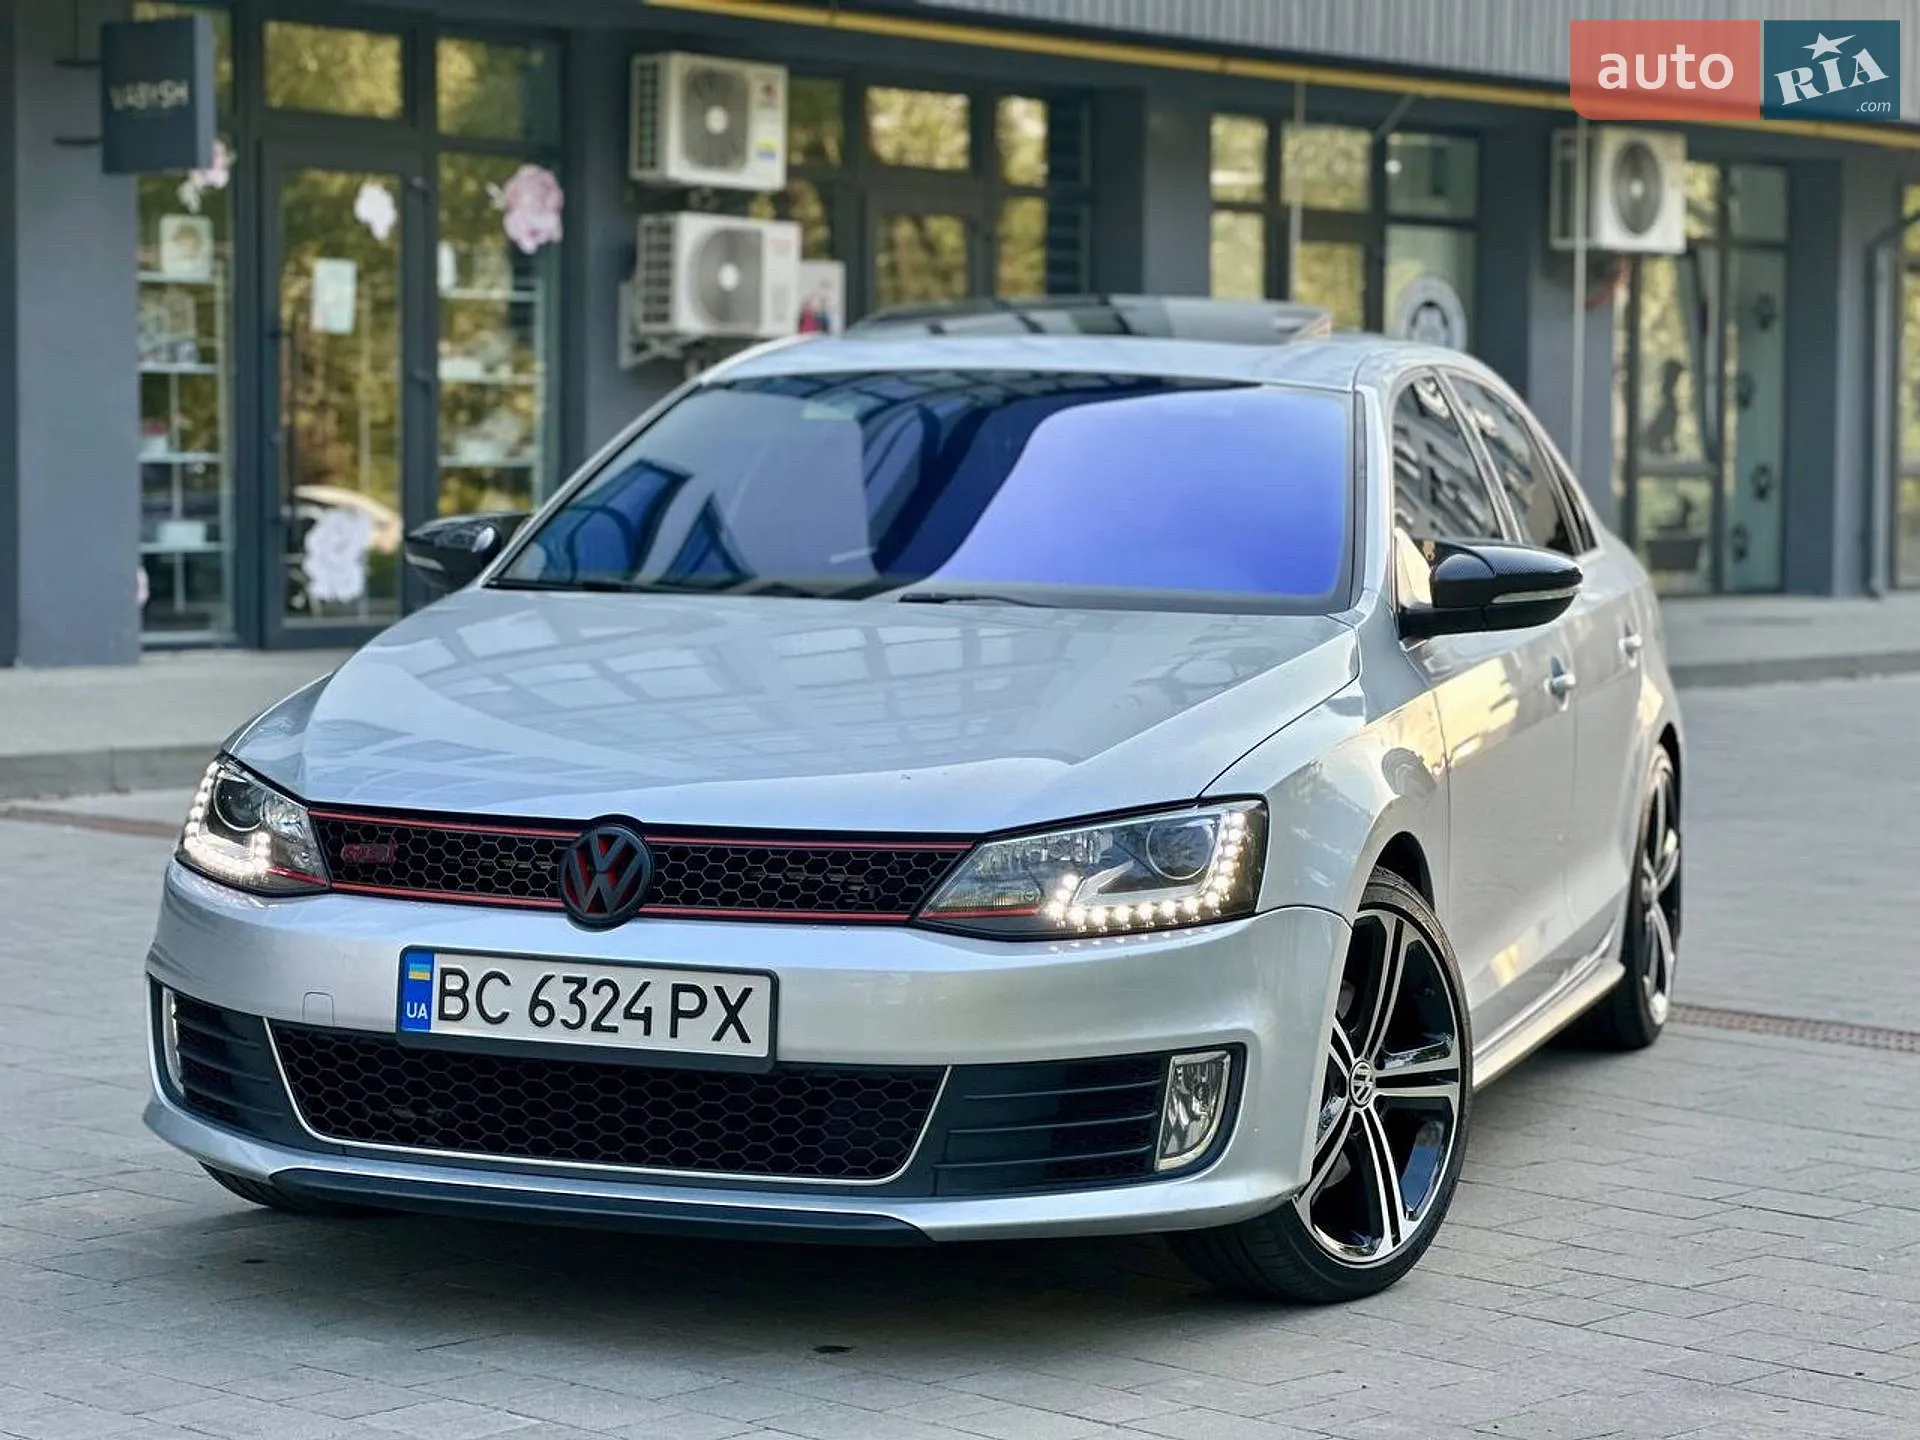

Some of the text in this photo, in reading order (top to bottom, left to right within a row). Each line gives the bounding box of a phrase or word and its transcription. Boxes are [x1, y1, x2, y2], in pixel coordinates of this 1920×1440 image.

[562, 825, 652, 922] VW
[406, 1003, 429, 1020] UA
[437, 967, 754, 1044] BC 6324 PX
